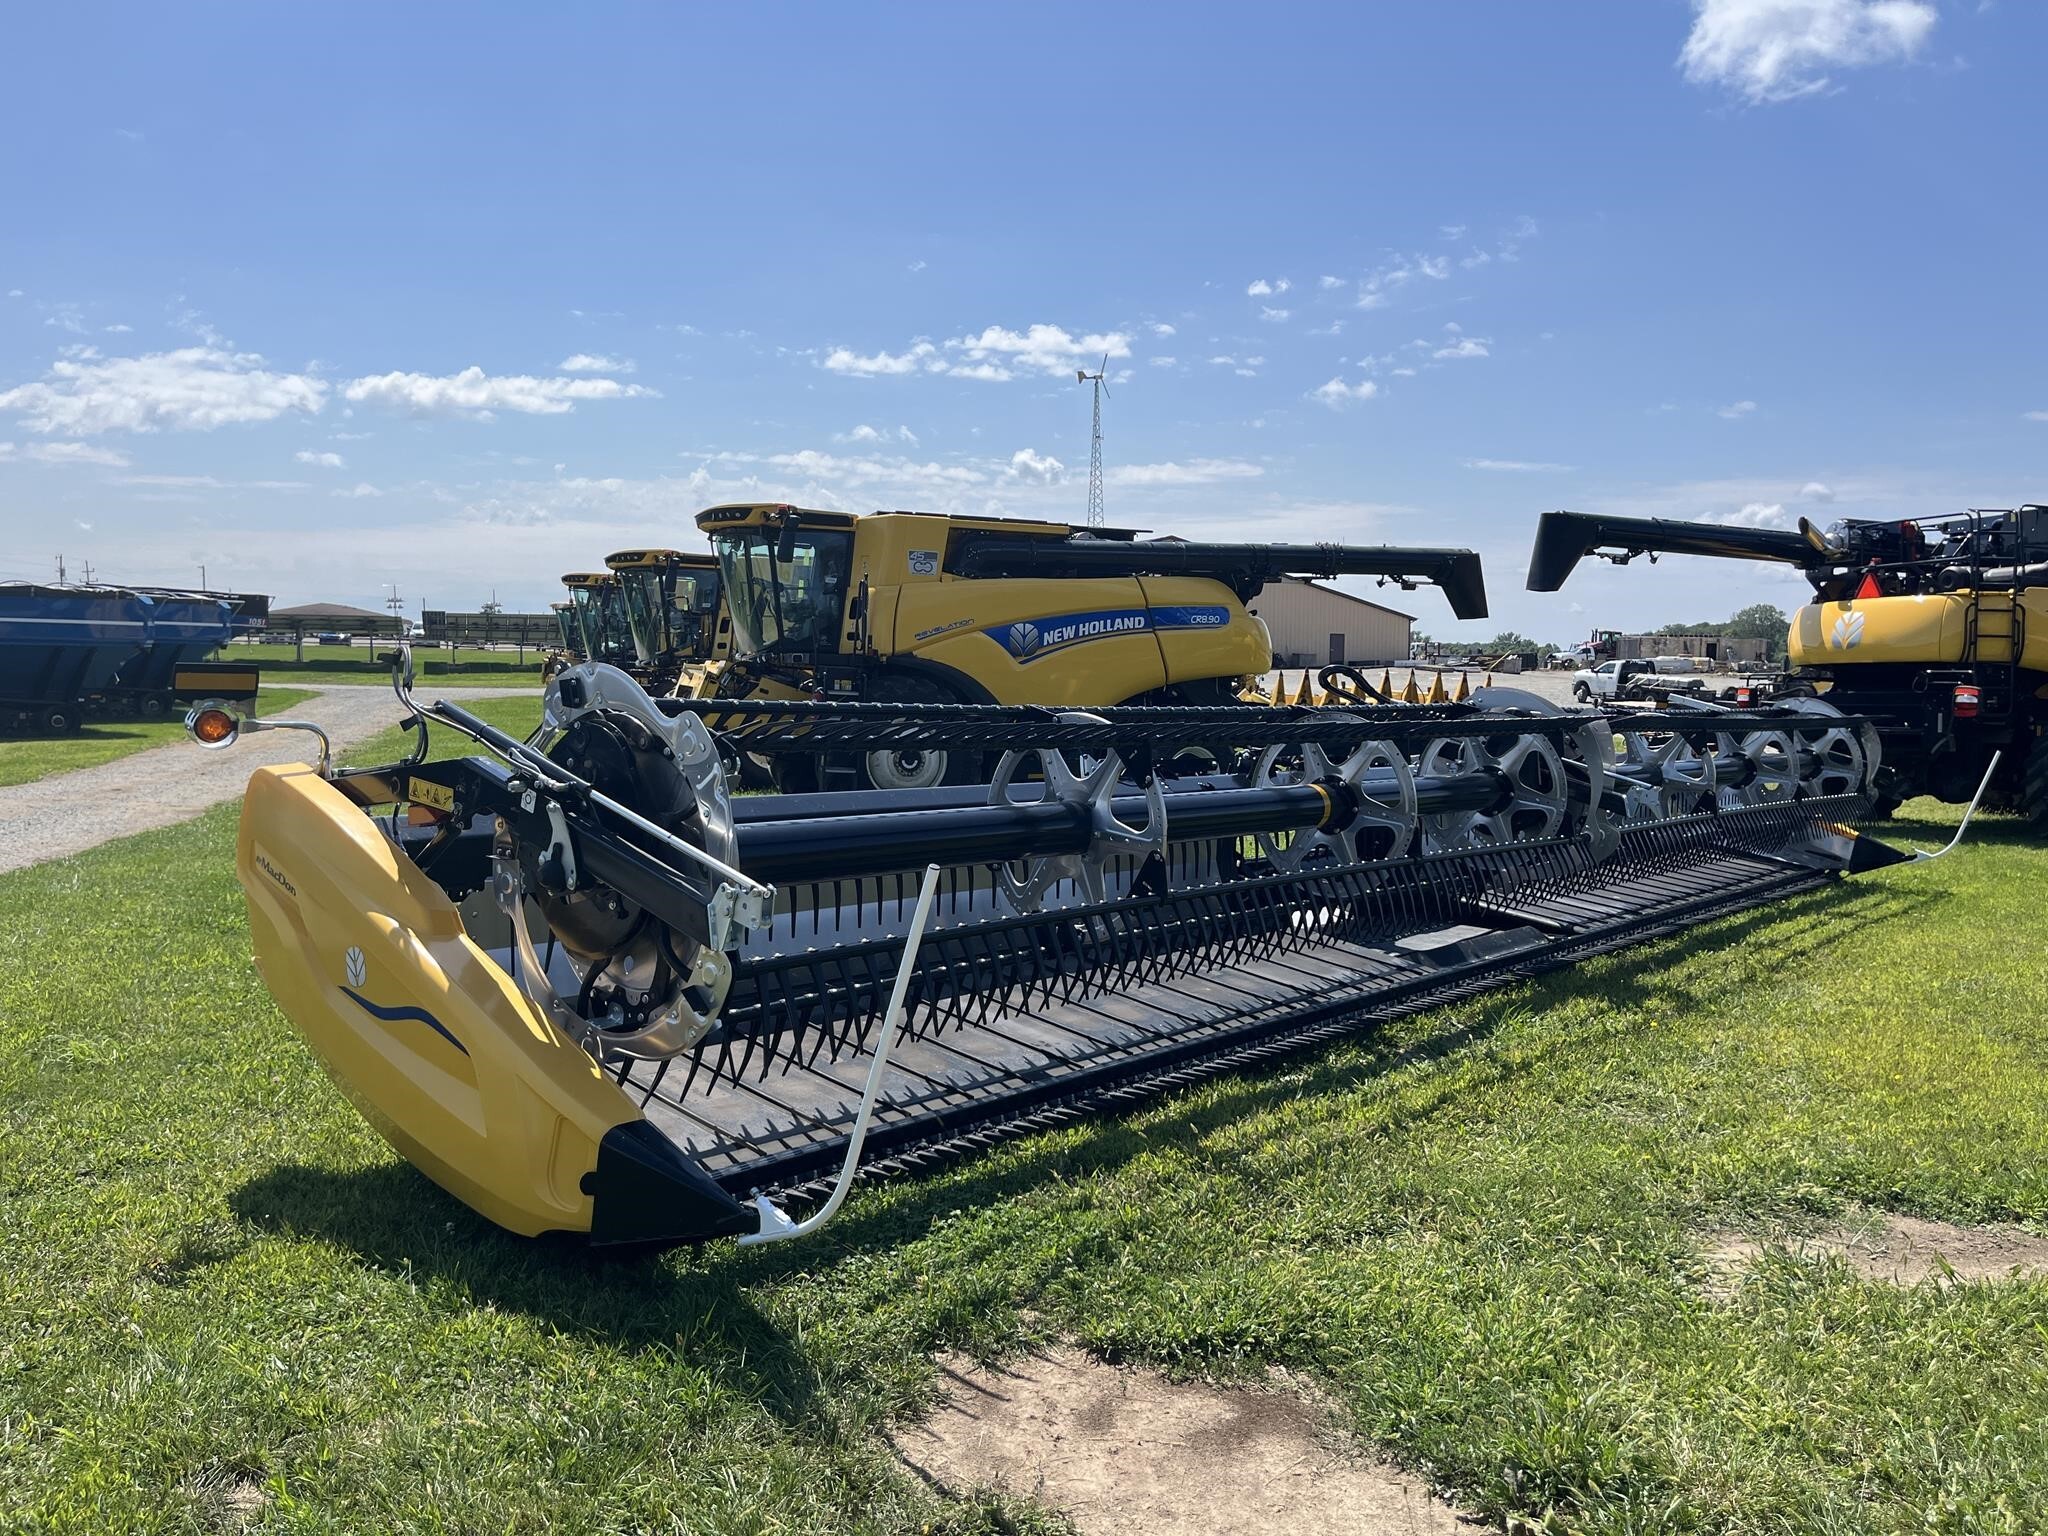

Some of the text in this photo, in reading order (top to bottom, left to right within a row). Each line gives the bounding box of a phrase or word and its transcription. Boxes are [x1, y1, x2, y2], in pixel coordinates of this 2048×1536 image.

[914, 617, 974, 638] REVELATION
[1043, 616, 1145, 646] NEW HOLLAND
[1190, 615, 1220, 624] CR8.90
[261, 857, 297, 896] MacDon
